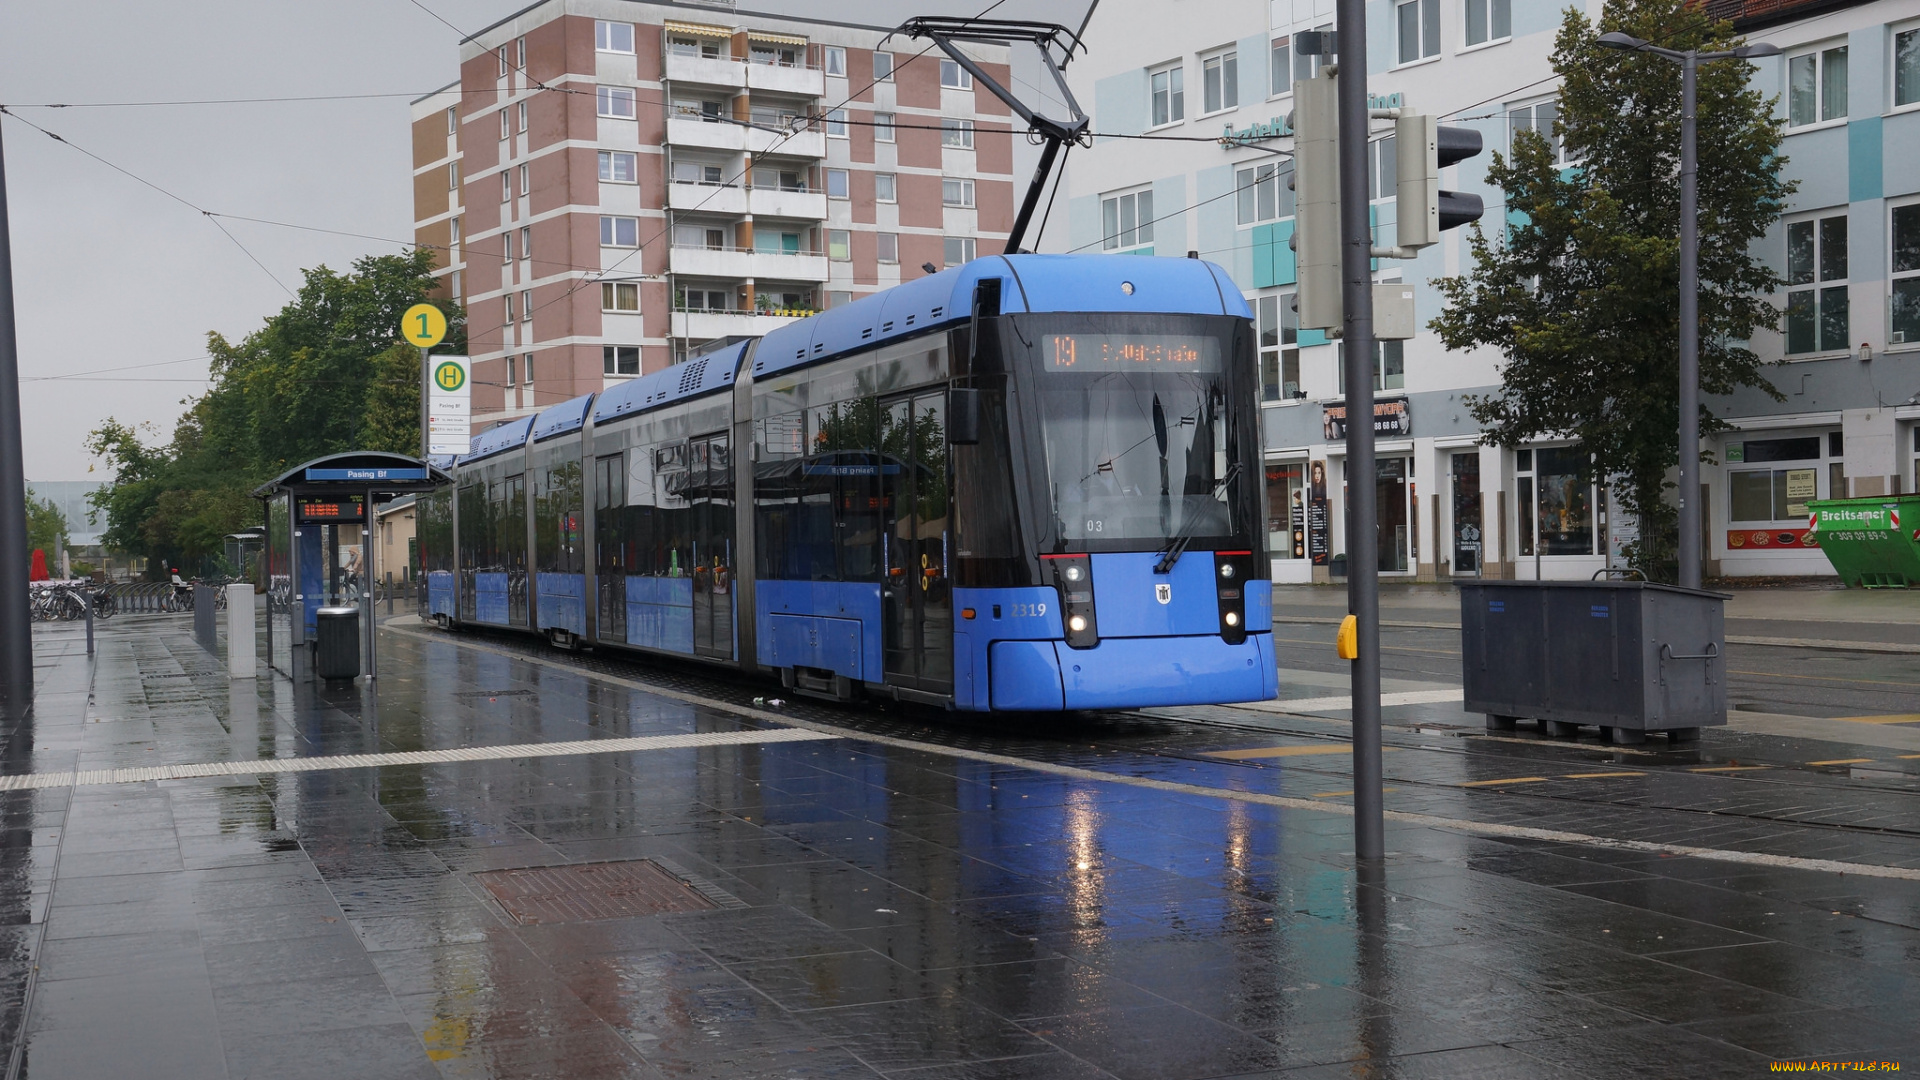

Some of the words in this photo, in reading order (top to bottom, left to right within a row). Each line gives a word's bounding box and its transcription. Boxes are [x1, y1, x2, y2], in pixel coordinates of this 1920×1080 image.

[416, 313, 432, 338] 1
[1055, 336, 1076, 366] 19
[443, 368, 456, 385] H
[1327, 407, 1346, 418] FRIS
[1382, 421, 1390, 429] 68
[1391, 420, 1398, 429] 68
[347, 471, 375, 479] Pasing
[1821, 510, 1885, 521] Breitsamer
[1087, 520, 1102, 531] 03
[1837, 531, 1853, 540] 309
[1011, 603, 1047, 617] 2319
